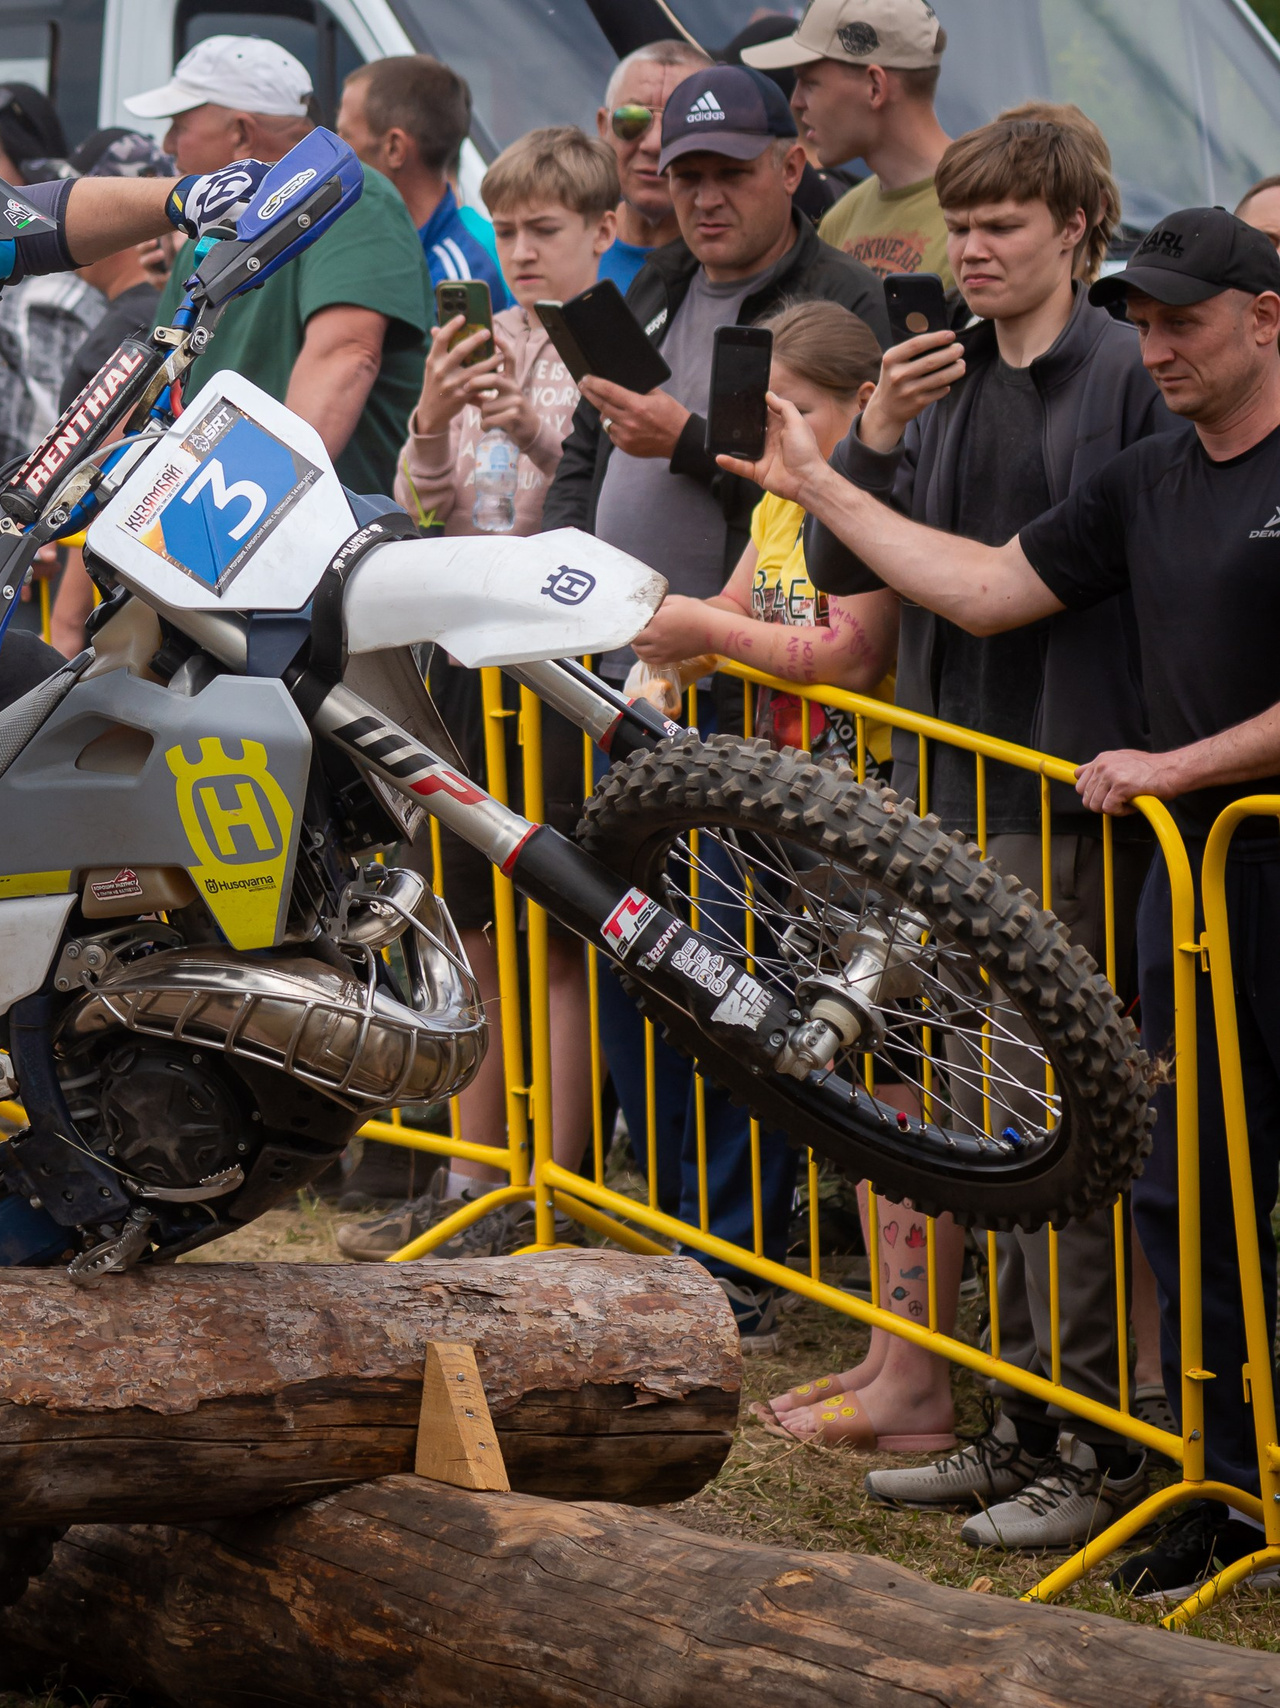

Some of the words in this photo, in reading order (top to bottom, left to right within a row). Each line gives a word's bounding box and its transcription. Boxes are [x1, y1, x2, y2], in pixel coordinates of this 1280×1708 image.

[686, 111, 725, 123] adidas
[25, 352, 143, 496] RENTHAL
[204, 406, 233, 440] SRT
[125, 463, 183, 533] КУЗЯМБАЙ
[181, 457, 267, 541] 3
[218, 875, 274, 892] Husqvarna
[617, 901, 661, 957] BLISS
